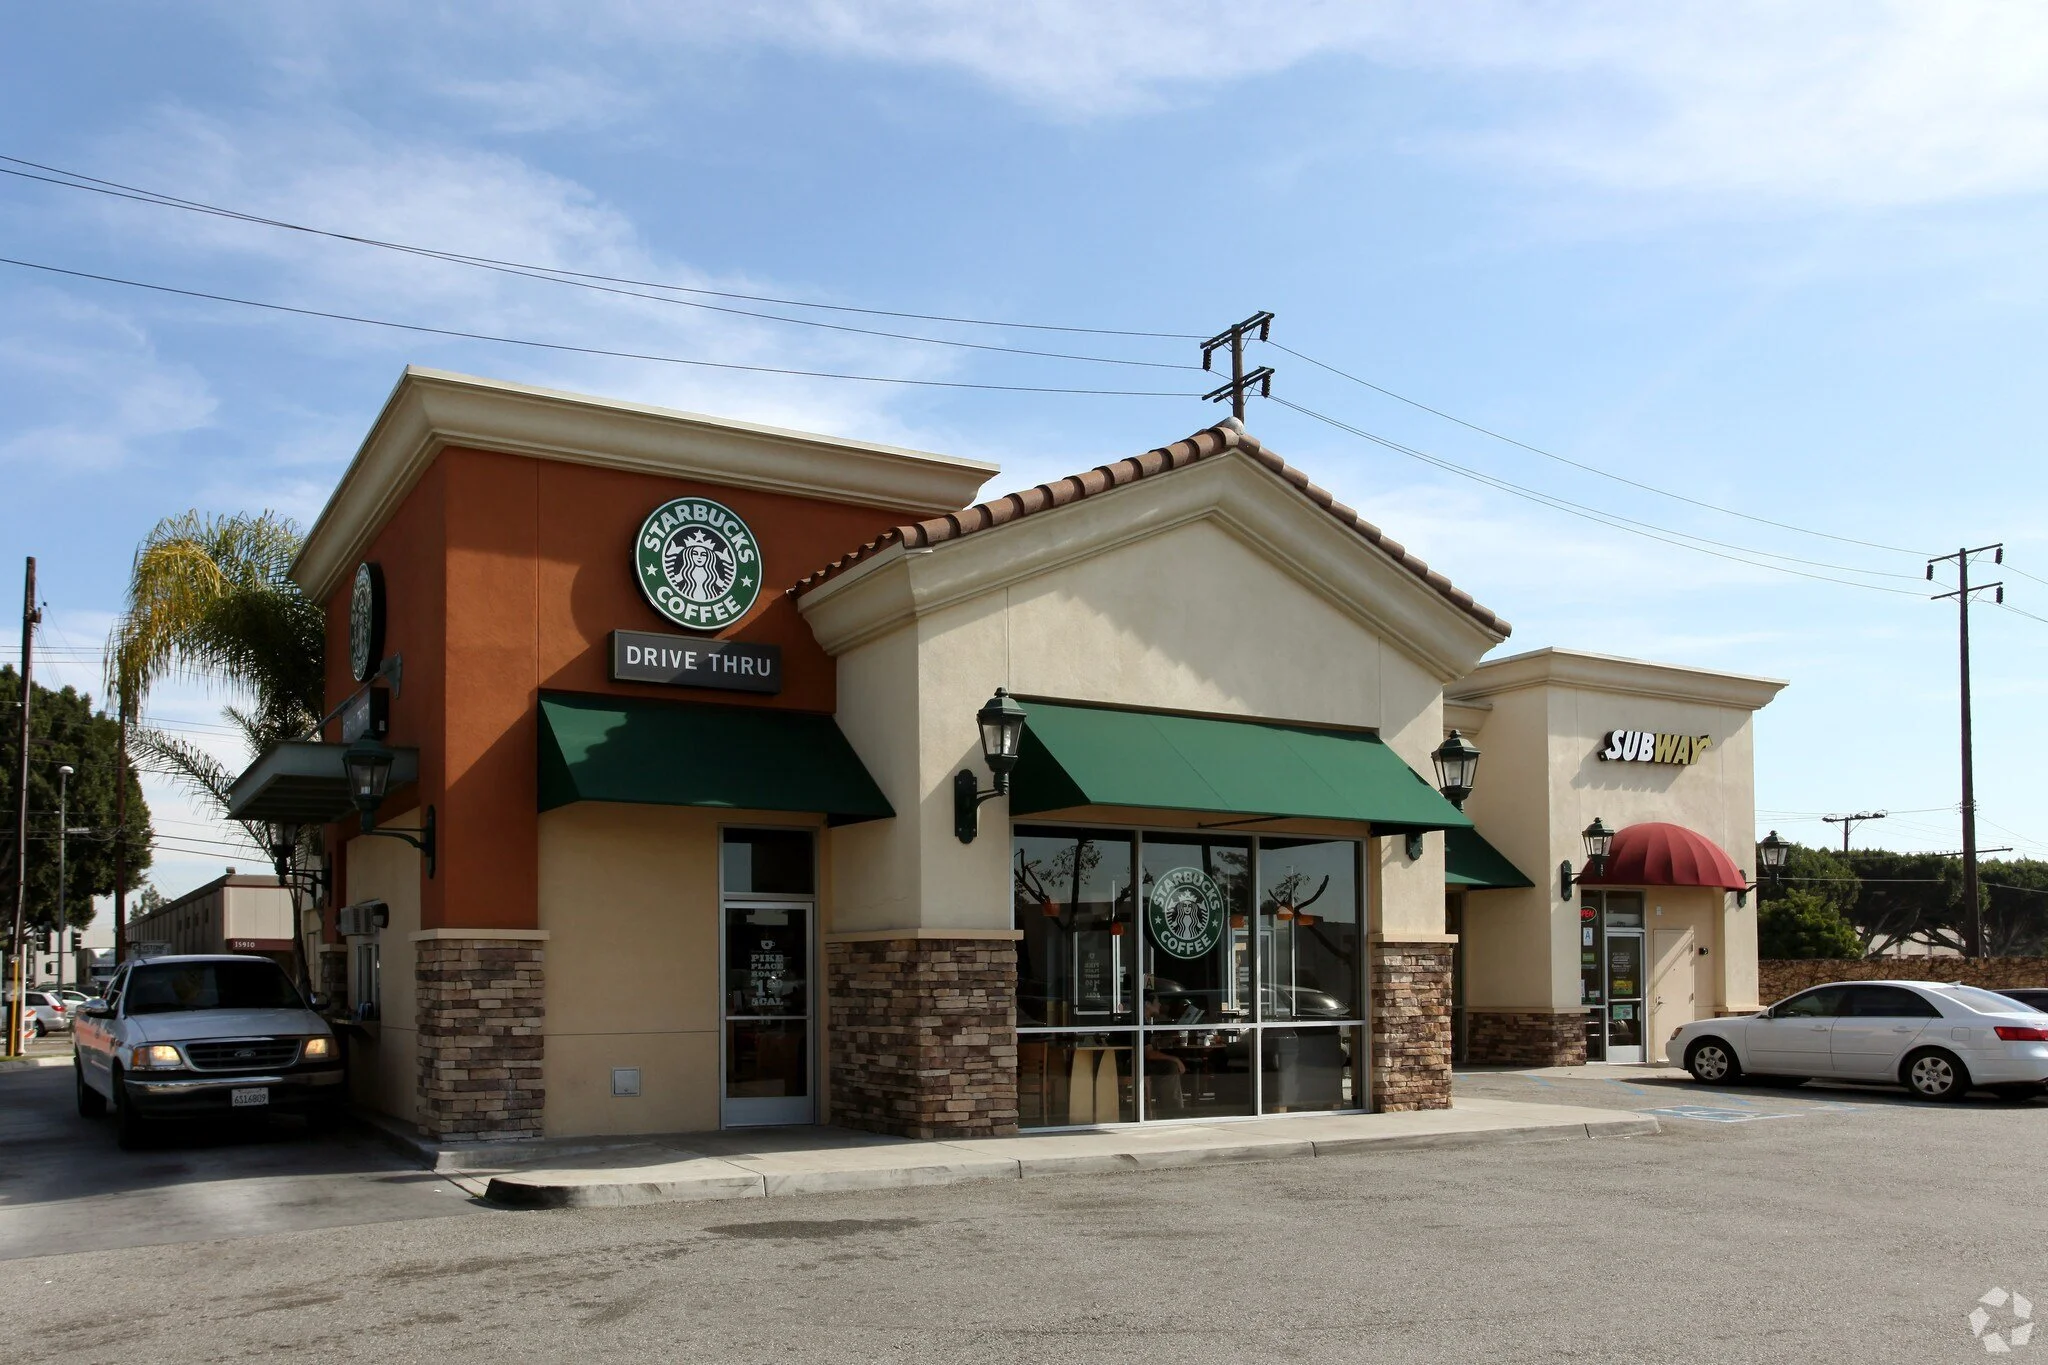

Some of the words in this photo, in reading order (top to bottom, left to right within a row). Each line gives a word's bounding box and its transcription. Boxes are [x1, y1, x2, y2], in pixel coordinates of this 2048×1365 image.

[643, 503, 755, 564] STARBUCKS
[656, 586, 741, 623] COFFEE
[626, 645, 698, 670] DRIVE
[708, 653, 771, 677] THRU
[1603, 729, 1713, 765] SUBWAY
[1153, 871, 1220, 911] STARBUCKS
[1581, 908, 1594, 916] PEN
[1160, 930, 1212, 955] COFFEE
[1585, 930, 1591, 940] A
[751, 954, 784, 962] PIKE
